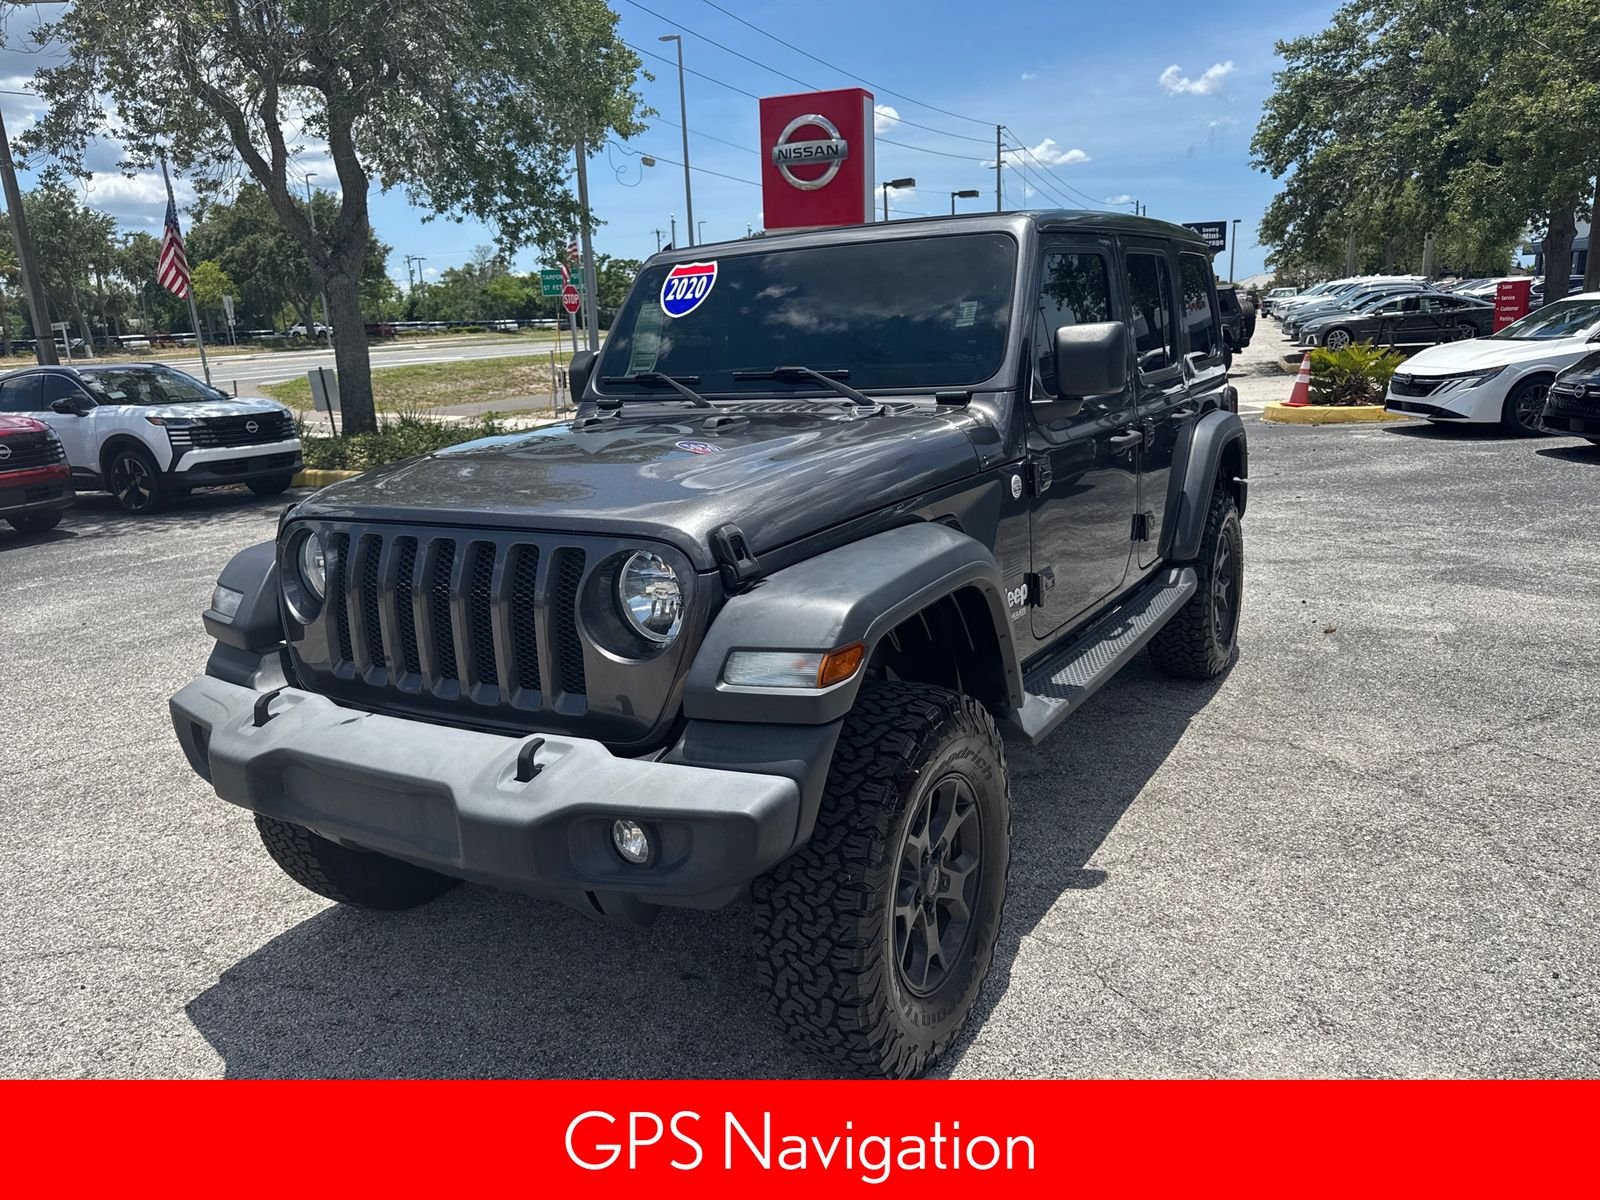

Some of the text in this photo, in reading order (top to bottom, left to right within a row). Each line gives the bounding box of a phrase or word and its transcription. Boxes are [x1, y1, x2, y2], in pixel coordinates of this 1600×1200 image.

[778, 145, 838, 160] NISSAN
[665, 276, 707, 301] 2020
[564, 294, 579, 304] STOP
